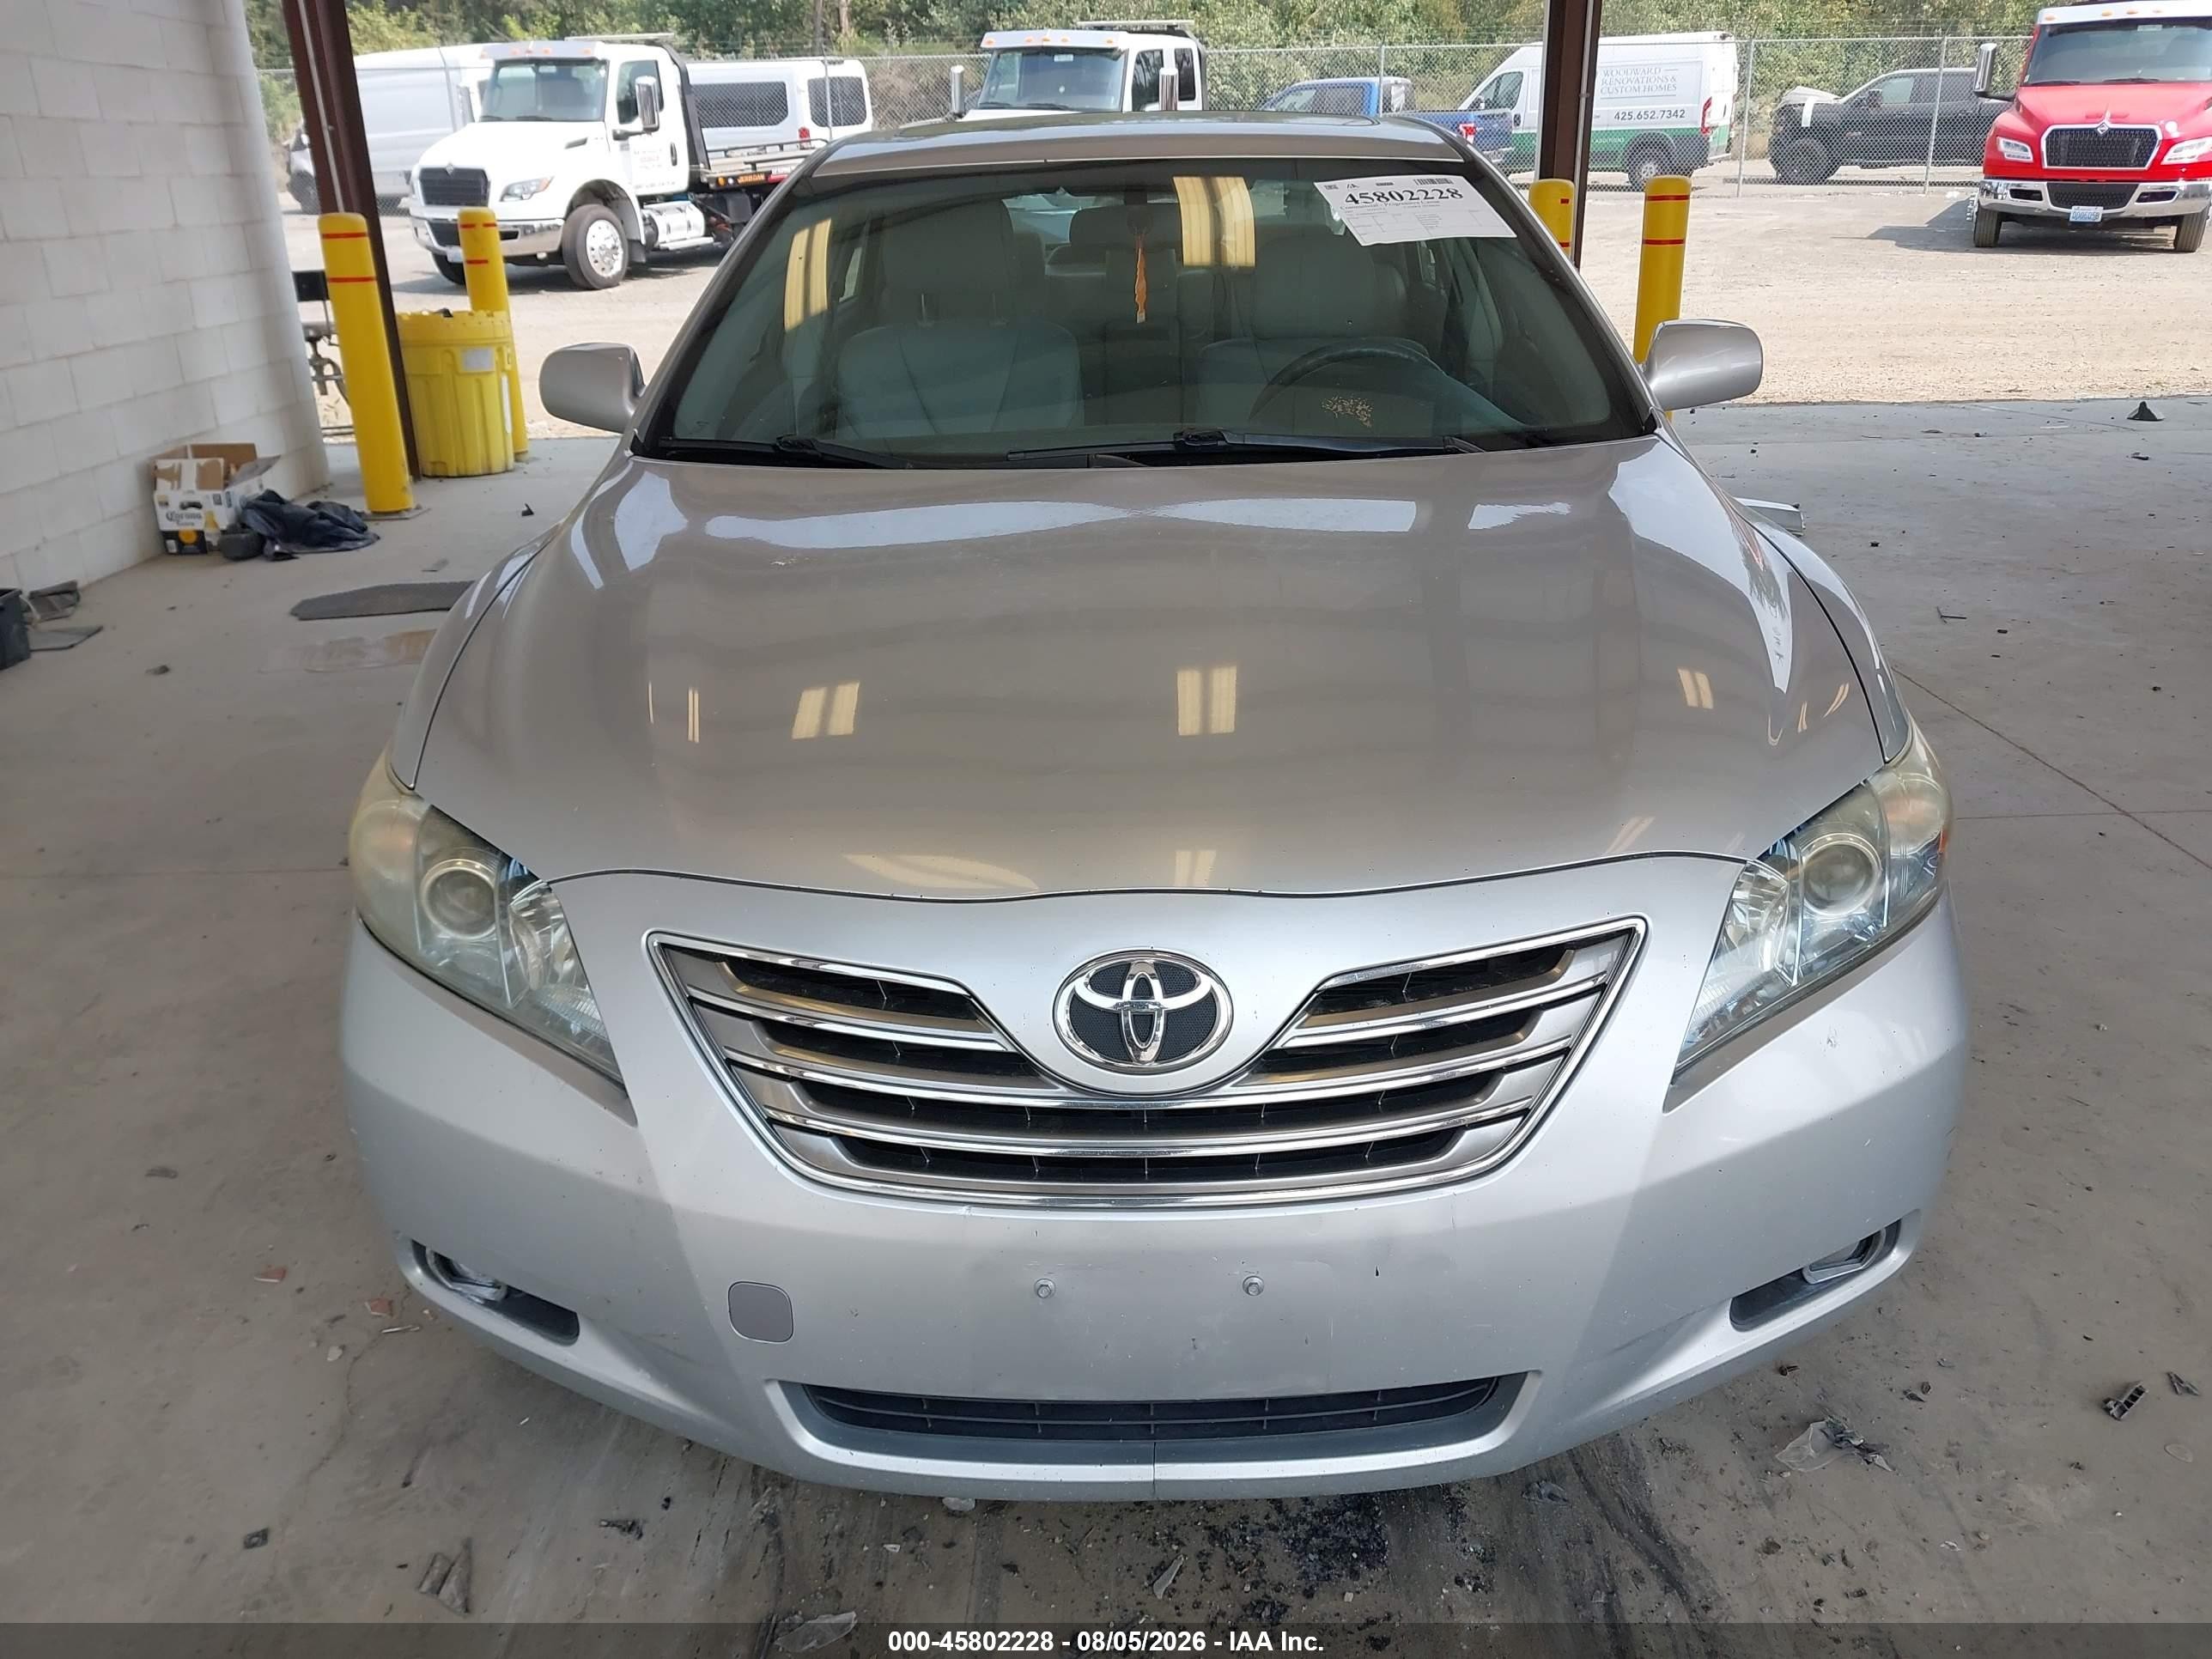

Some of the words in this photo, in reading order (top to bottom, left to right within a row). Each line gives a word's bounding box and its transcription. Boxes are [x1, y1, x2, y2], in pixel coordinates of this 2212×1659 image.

[1602, 67, 1662, 77] WOODWARD
[1601, 75, 1669, 86] RENOVATIONS
[1600, 84, 1641, 94] CUSTOM
[1644, 83, 1677, 93] HOMES
[1614, 109, 1686, 121] 425.652.7342
[1345, 187, 1464, 205] 45802228
